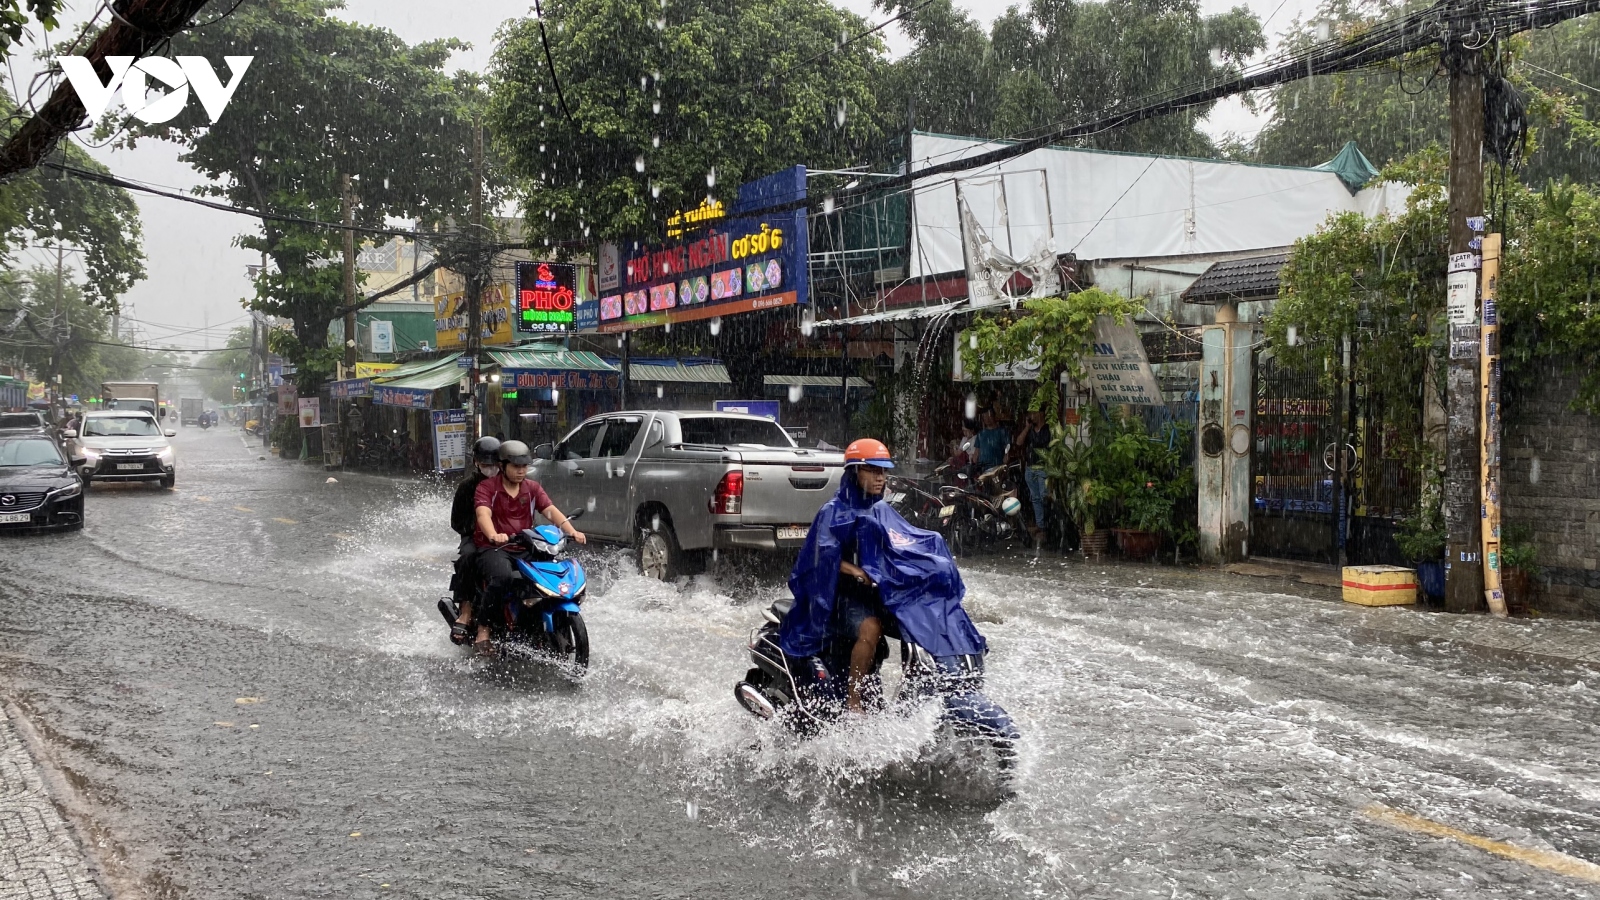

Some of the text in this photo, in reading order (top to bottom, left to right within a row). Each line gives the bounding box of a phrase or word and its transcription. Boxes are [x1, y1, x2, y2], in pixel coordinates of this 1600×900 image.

[653, 243, 685, 279] HÙNG
[688, 229, 728, 269] NGÂN
[732, 233, 751, 259] CƠ
[751, 222, 771, 254] SỞ
[771, 228, 783, 249] 6
[521, 286, 573, 310] PHỞ
[522, 309, 573, 322] HÙNG NGÂN
[518, 372, 536, 387] BÚN
[538, 372, 548, 387] BÒ
[550, 371, 567, 388] HUẾ
